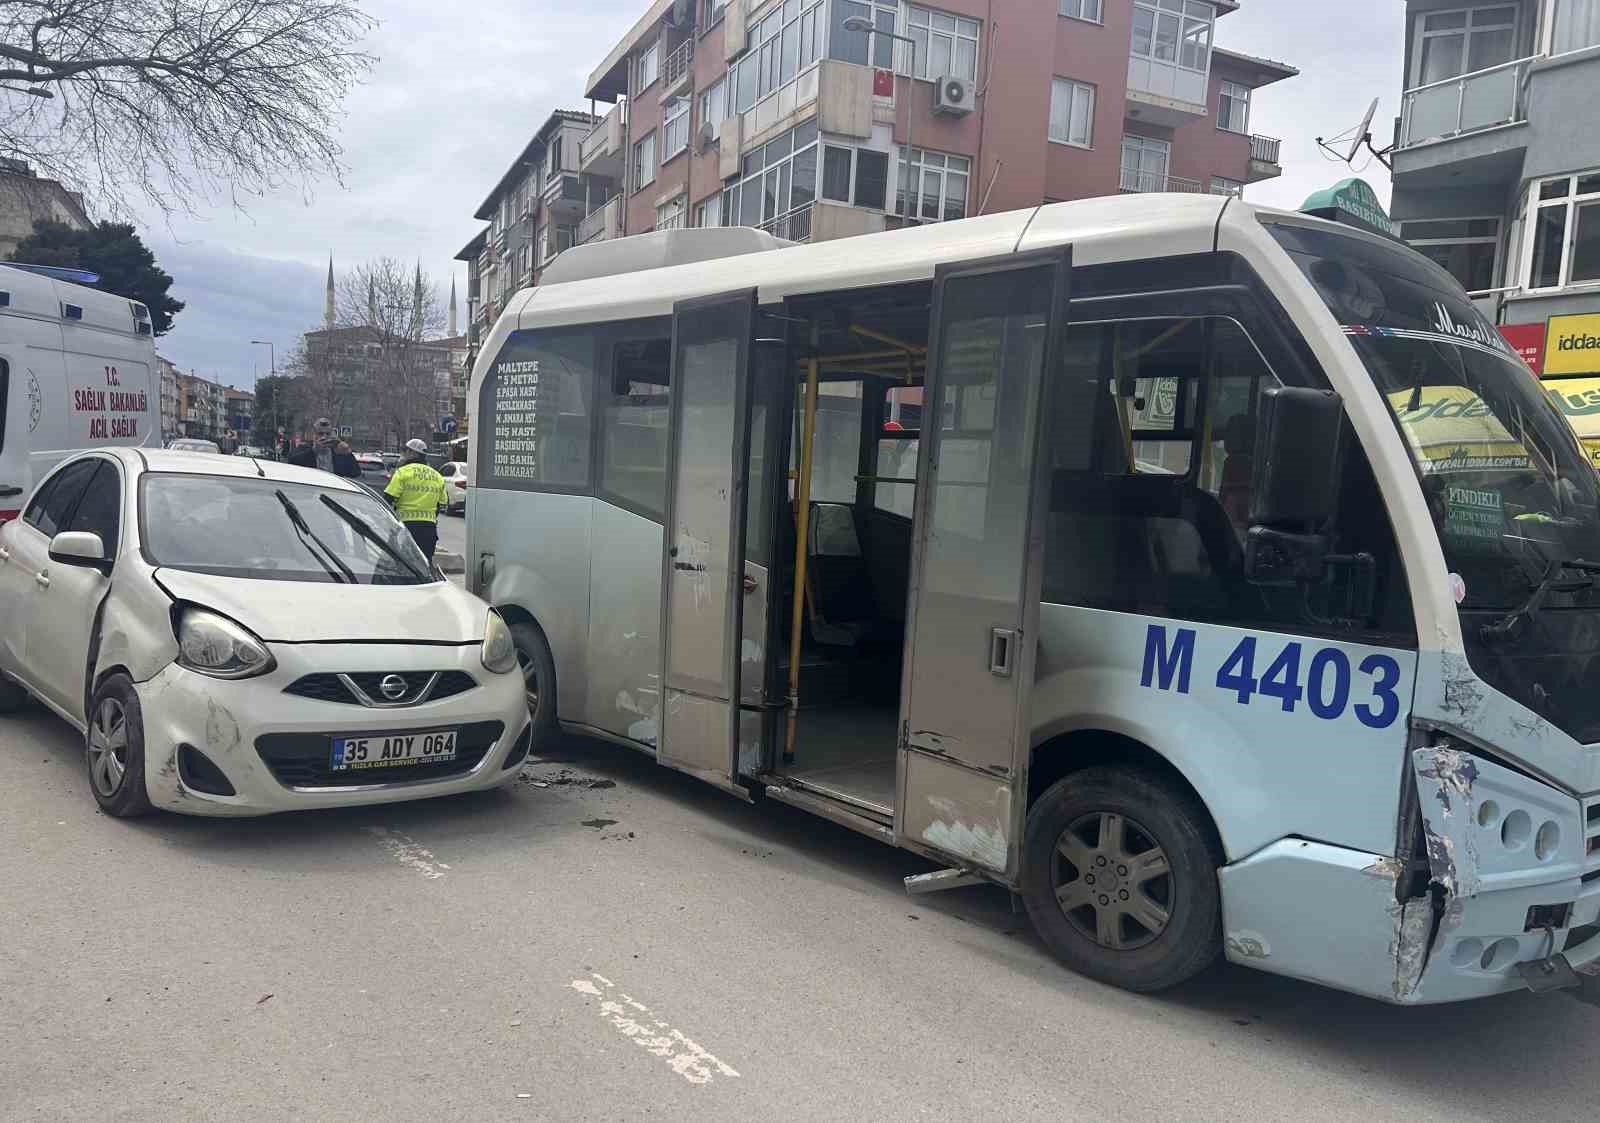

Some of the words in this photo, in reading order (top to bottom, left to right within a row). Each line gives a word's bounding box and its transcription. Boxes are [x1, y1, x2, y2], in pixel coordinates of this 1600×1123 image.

[105, 366, 120, 387] T.C.
[498, 361, 539, 373] MALTEPE
[510, 374, 538, 385] METRO
[74, 387, 106, 411] SAĞLIK
[110, 390, 148, 412] BAKANLIĞI
[90, 415, 108, 439] ACİL
[111, 416, 138, 438] SAĞLIK
[494, 466, 535, 478] MARMARAY
[1140, 624, 1196, 694] M
[1216, 636, 1400, 728] 4403
[345, 740, 369, 761] 35
[381, 737, 416, 759] ADY
[423, 734, 455, 755] 064
